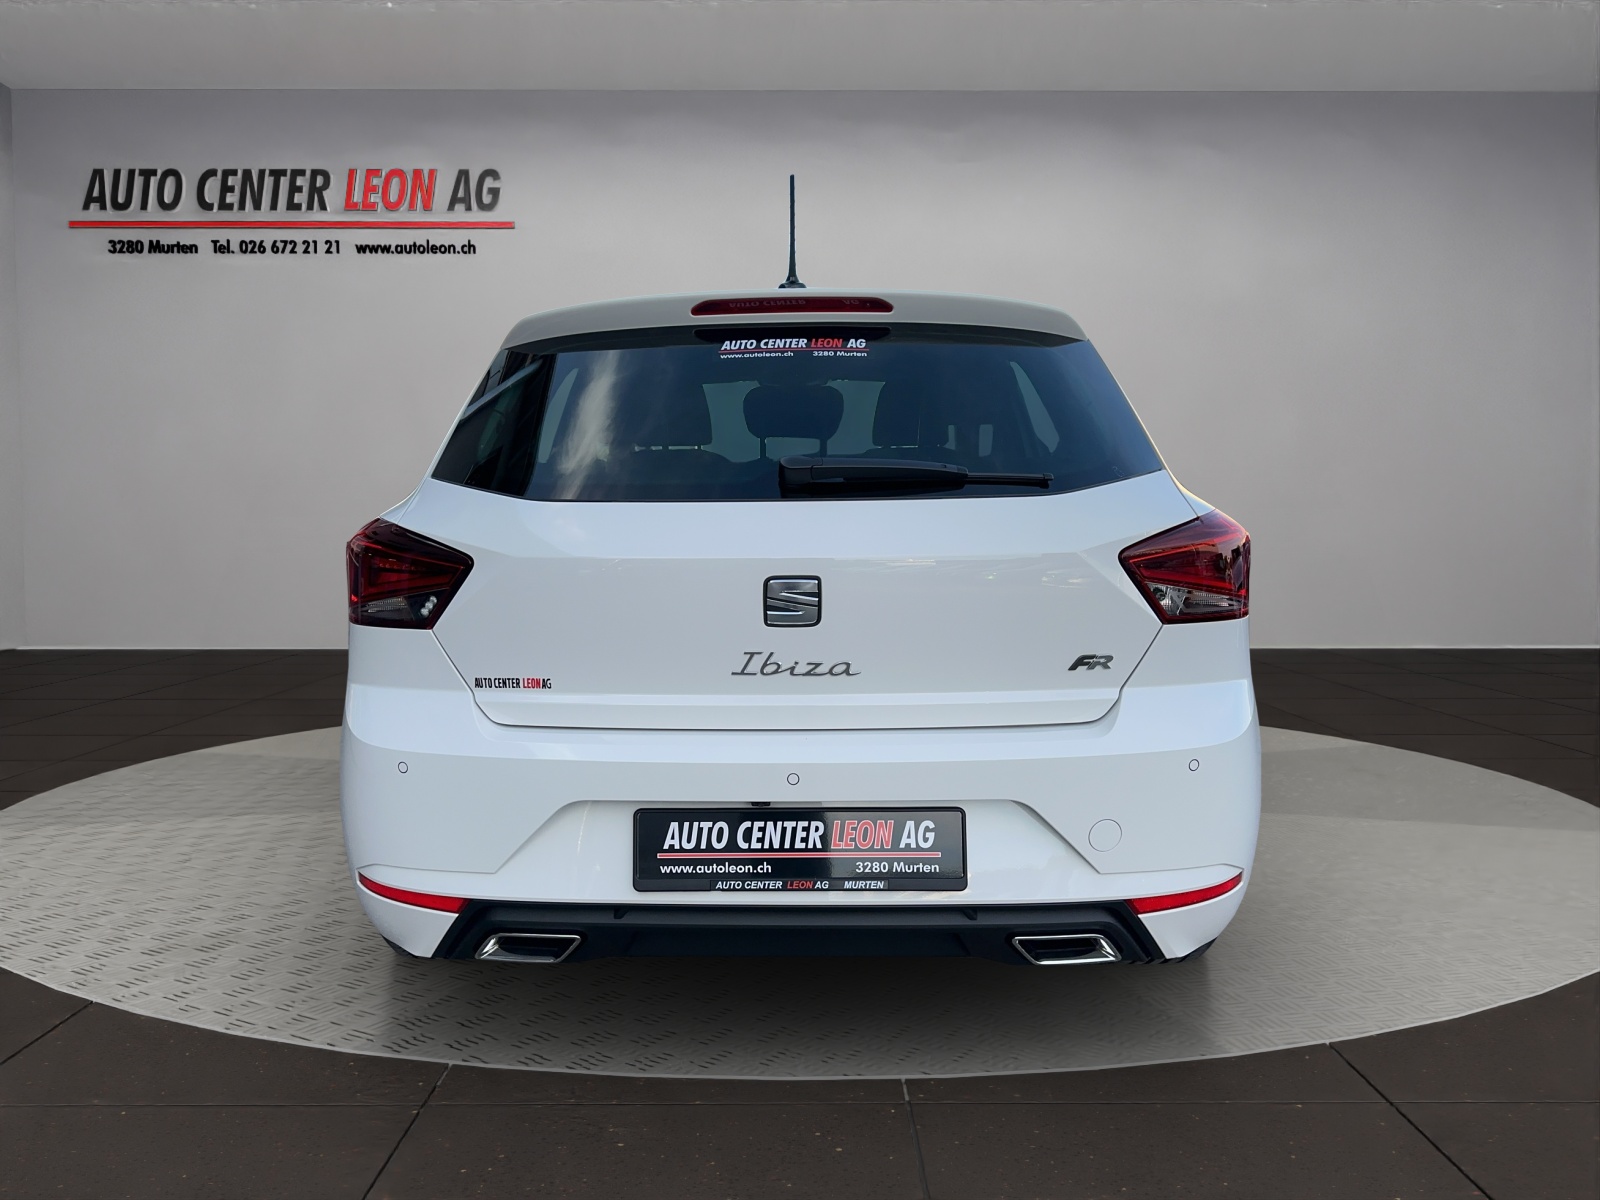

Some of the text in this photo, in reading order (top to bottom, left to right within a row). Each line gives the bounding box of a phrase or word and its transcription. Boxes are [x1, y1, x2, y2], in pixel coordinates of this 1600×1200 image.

[82, 168, 502, 212] AUTO CENTER LEON AG
[107, 239, 477, 256] 3280 Murten Tel. 026 672 21 21 www.autoleon.ch
[721, 338, 867, 350] AUTO CENTER LEON AG
[720, 351, 794, 359] www.autoleon.ch
[731, 652, 862, 676] Ibiza
[1067, 654, 1114, 671] FR
[474, 677, 552, 689] AUTO CENTER LEON AG
[663, 820, 936, 850] AUTO CENTER LEON AG
[660, 862, 940, 875] www.autoleon.ch 3280 Murten
[715, 881, 884, 889] AUTO CENTER LEON AG MURTEN
